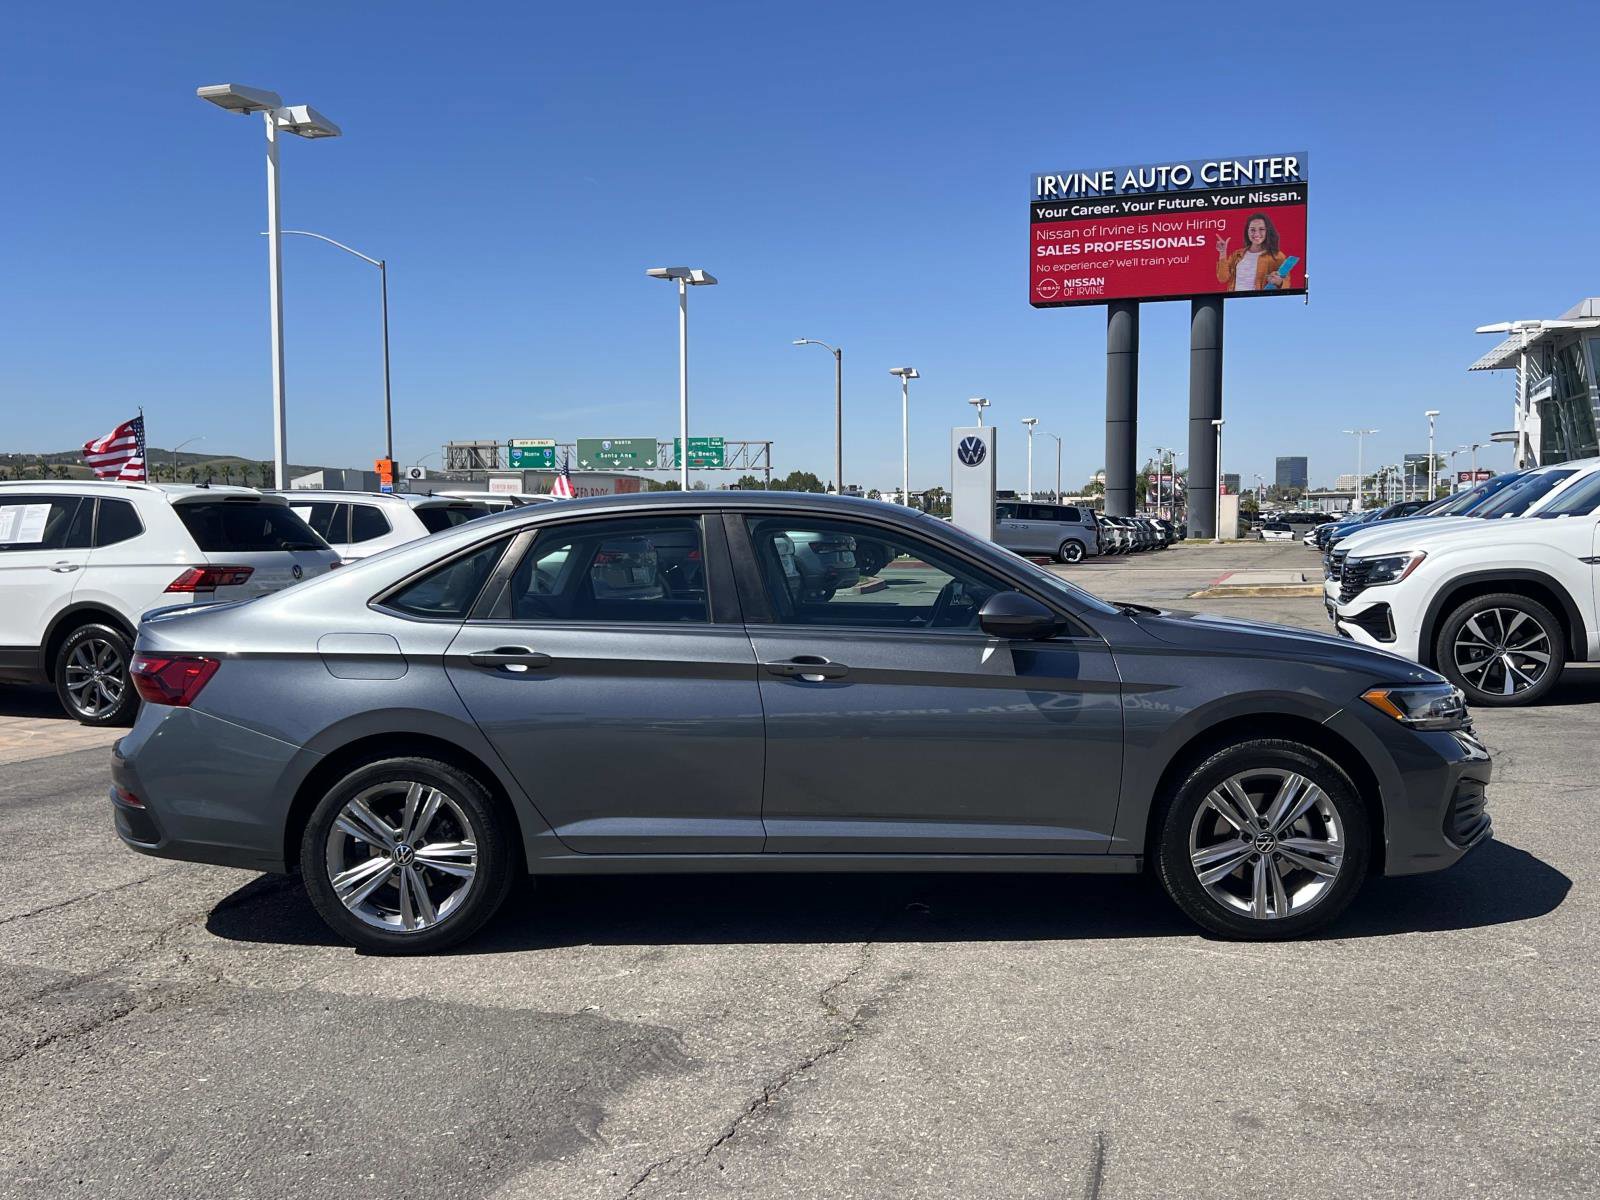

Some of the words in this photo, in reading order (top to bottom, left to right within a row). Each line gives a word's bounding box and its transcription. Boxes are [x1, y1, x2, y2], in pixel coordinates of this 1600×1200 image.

[1037, 171, 1114, 195] IRVINE
[1121, 164, 1192, 189] AUTO
[1200, 156, 1299, 183] CENTER
[1036, 208, 1068, 218] Your
[1071, 204, 1119, 216] Career.
[1122, 201, 1154, 212] Your
[1158, 198, 1208, 209] Future.
[1211, 195, 1245, 206] Your
[1248, 191, 1301, 203] Nissan.
[1036, 229, 1080, 240] Nissan
[1083, 225, 1097, 237] of
[1099, 224, 1135, 237] Irvine
[1138, 223, 1148, 233] is
[1152, 222, 1183, 232] Now
[1186, 219, 1226, 231] Hiring
[1036, 243, 1081, 257] SALES
[1084, 235, 1206, 253] PROFESSIONALS
[1036, 264, 1051, 272] No
[1053, 259, 1115, 272] experience?
[1116, 257, 1139, 268] We'll
[1141, 256, 1165, 266] train
[1167, 255, 1190, 266] you!
[1063, 277, 1105, 287] NISSAN
[1063, 287, 1075, 296] OF
[1076, 286, 1105, 296] IRVINE
